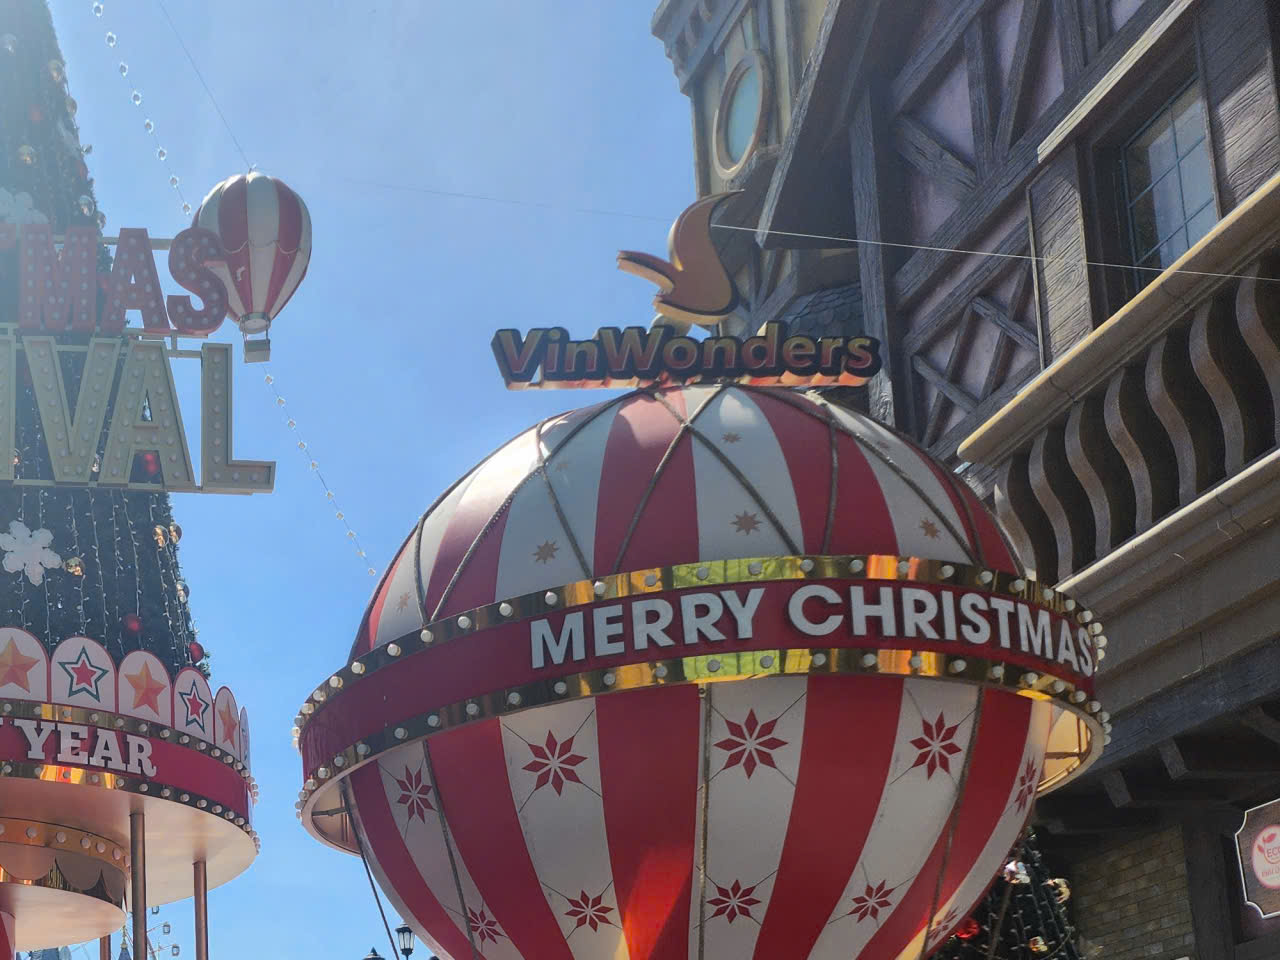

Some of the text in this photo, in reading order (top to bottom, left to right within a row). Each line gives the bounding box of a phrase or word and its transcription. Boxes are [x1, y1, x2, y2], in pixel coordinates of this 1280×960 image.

[496, 322, 878, 378] VinWonders
[530, 584, 1094, 677] MERRY CHRISTMAS
[15, 716, 157, 777] YEAR
